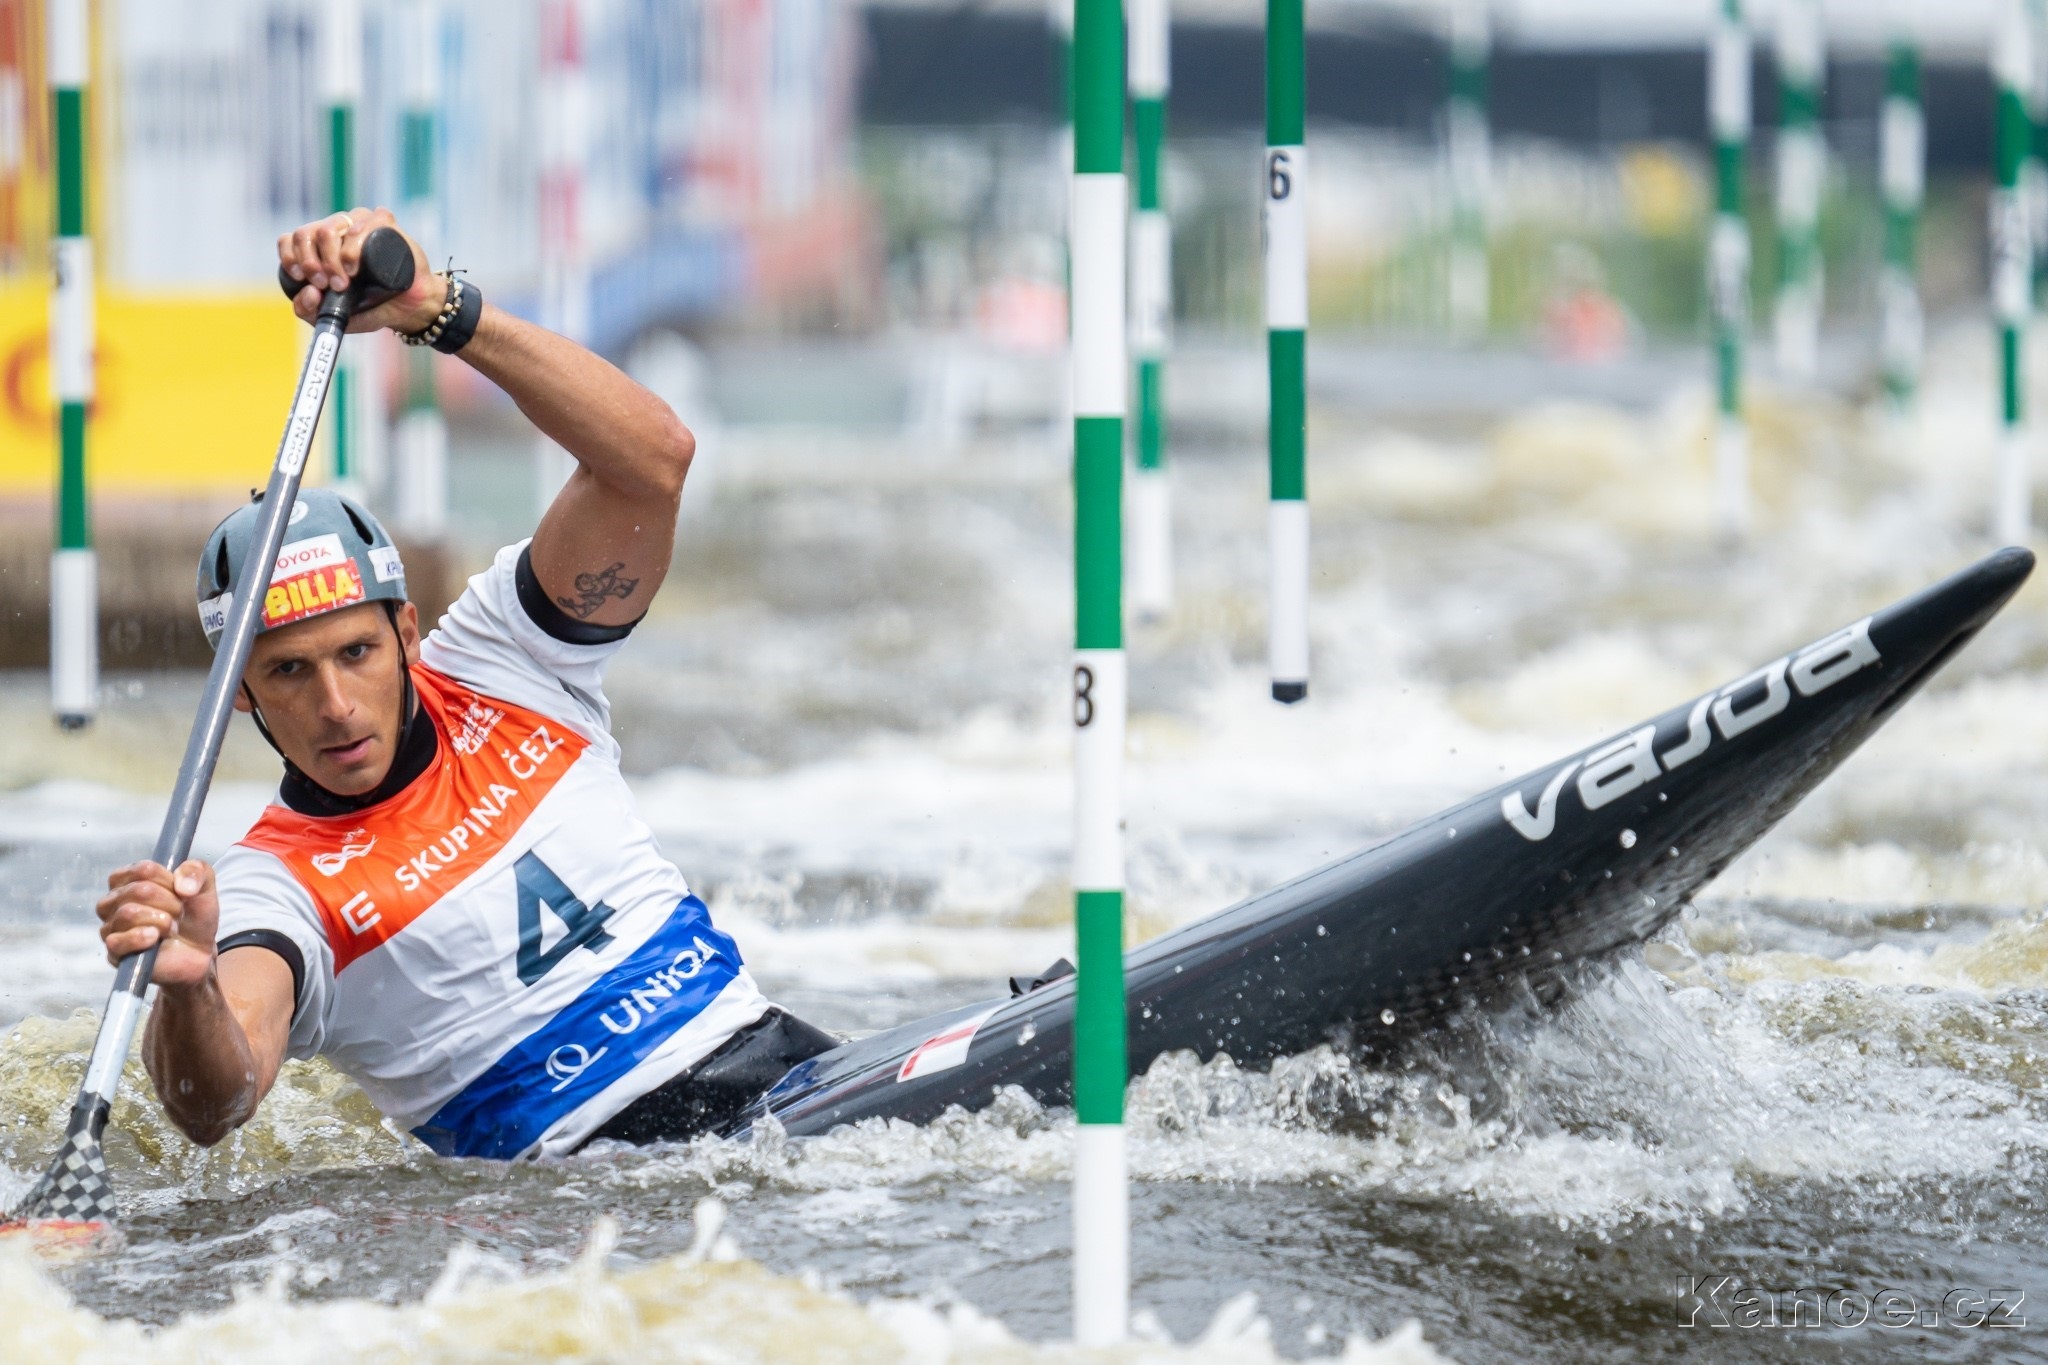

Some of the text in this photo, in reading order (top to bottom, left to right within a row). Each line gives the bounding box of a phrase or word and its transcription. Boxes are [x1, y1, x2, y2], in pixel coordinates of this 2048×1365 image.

[1269, 150, 1291, 200] 6
[274, 546, 332, 571] OYOTA
[265, 567, 356, 619] BILLA
[203, 610, 225, 631] PMG
[394, 725, 565, 892] SKUPINA ČEZ
[513, 849, 617, 987] 4
[600, 936, 721, 1034] UNIQA
